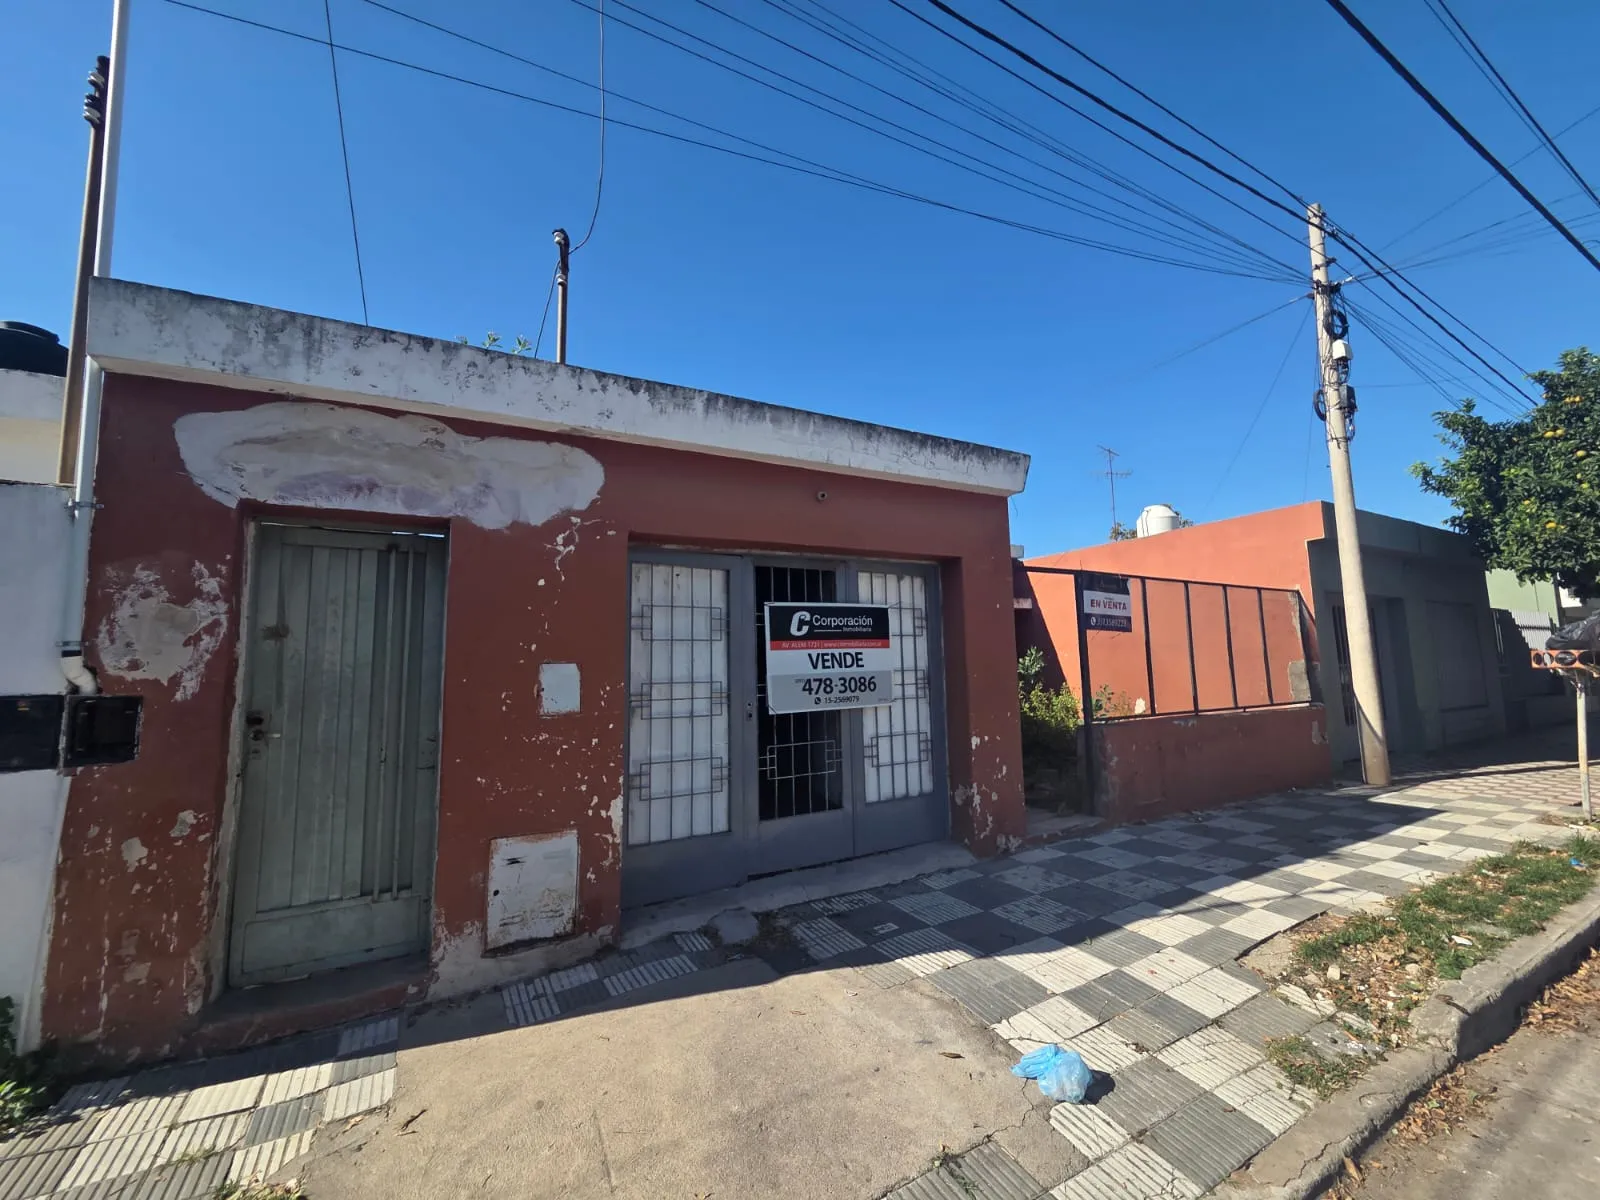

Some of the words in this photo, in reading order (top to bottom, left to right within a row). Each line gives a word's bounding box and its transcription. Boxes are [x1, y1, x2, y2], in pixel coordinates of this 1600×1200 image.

[1090, 599, 1101, 608] EN
[1103, 600, 1127, 610] VENTA
[812, 615, 873, 628] Corporación
[808, 652, 864, 670] VENDE
[802, 676, 877, 695] 478-3086
